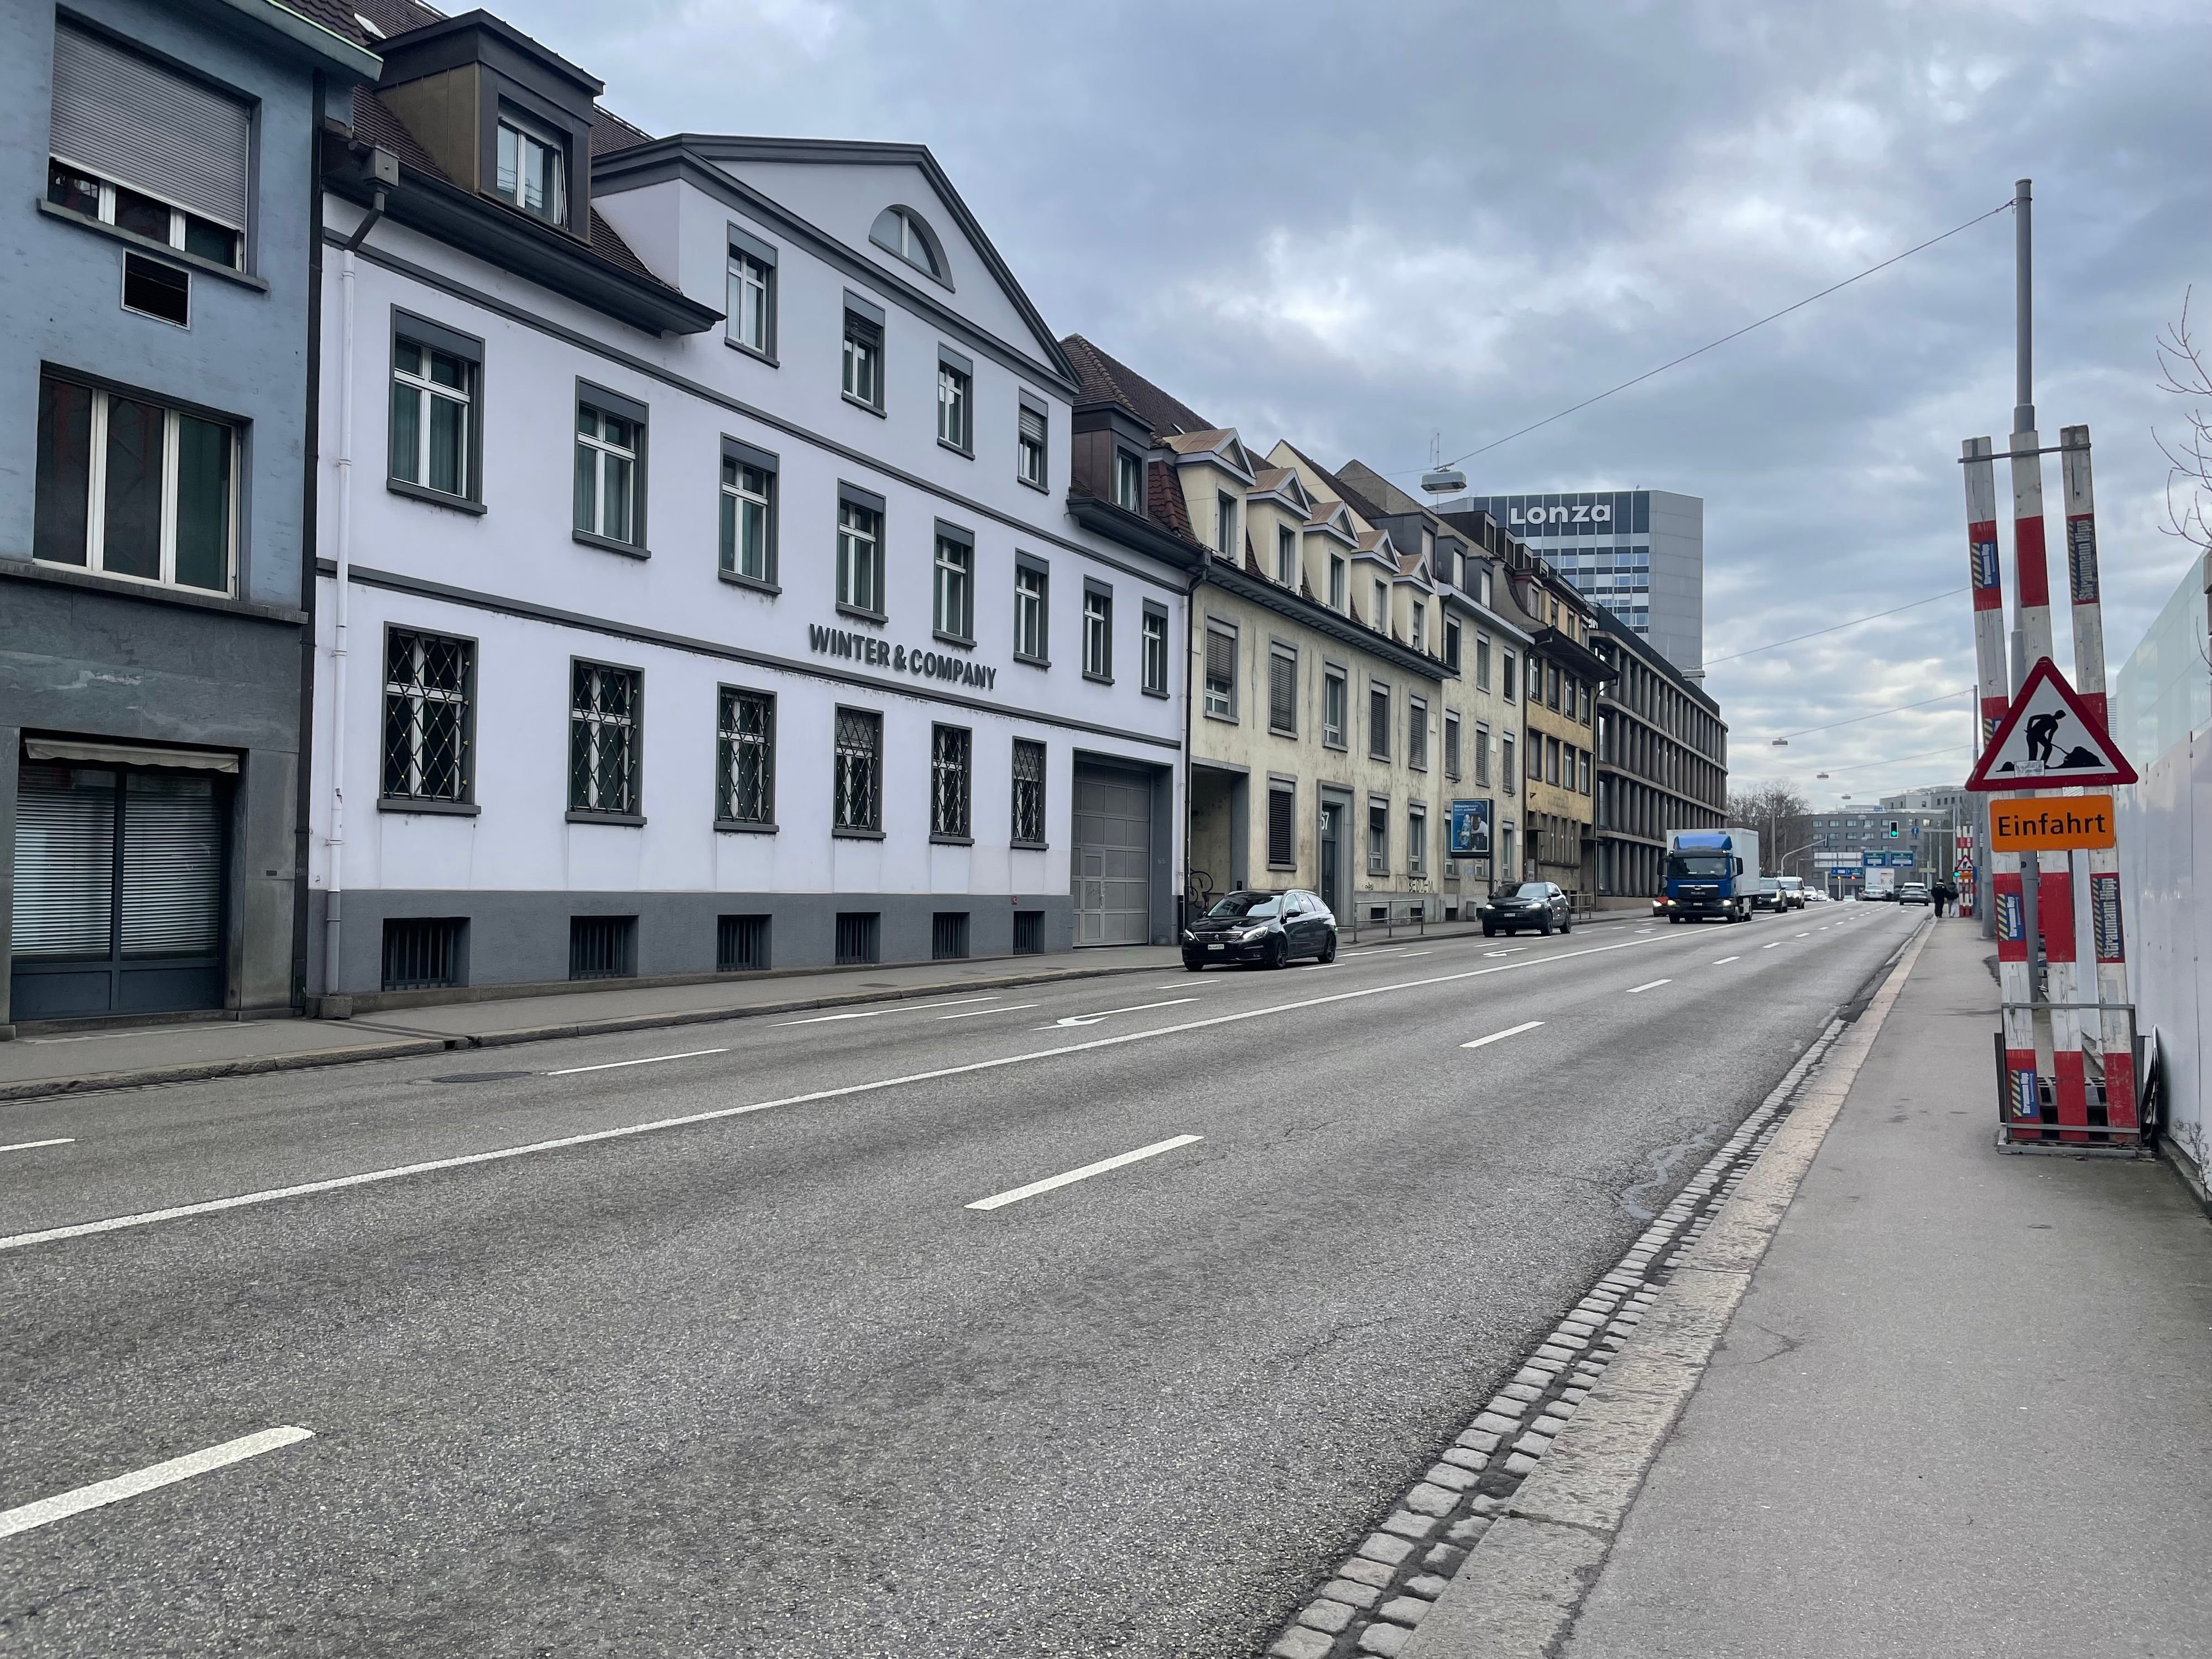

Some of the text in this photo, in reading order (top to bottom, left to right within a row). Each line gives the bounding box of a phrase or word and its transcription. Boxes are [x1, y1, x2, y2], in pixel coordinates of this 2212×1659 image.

[1510, 504, 1611, 525] Lonza
[2074, 520, 2094, 600] Straumann Hipp
[810, 623, 997, 690] WINTER & COMPANY
[1998, 812, 2106, 836] Einfahrt
[2100, 878, 2119, 958] Straumann Hipp
